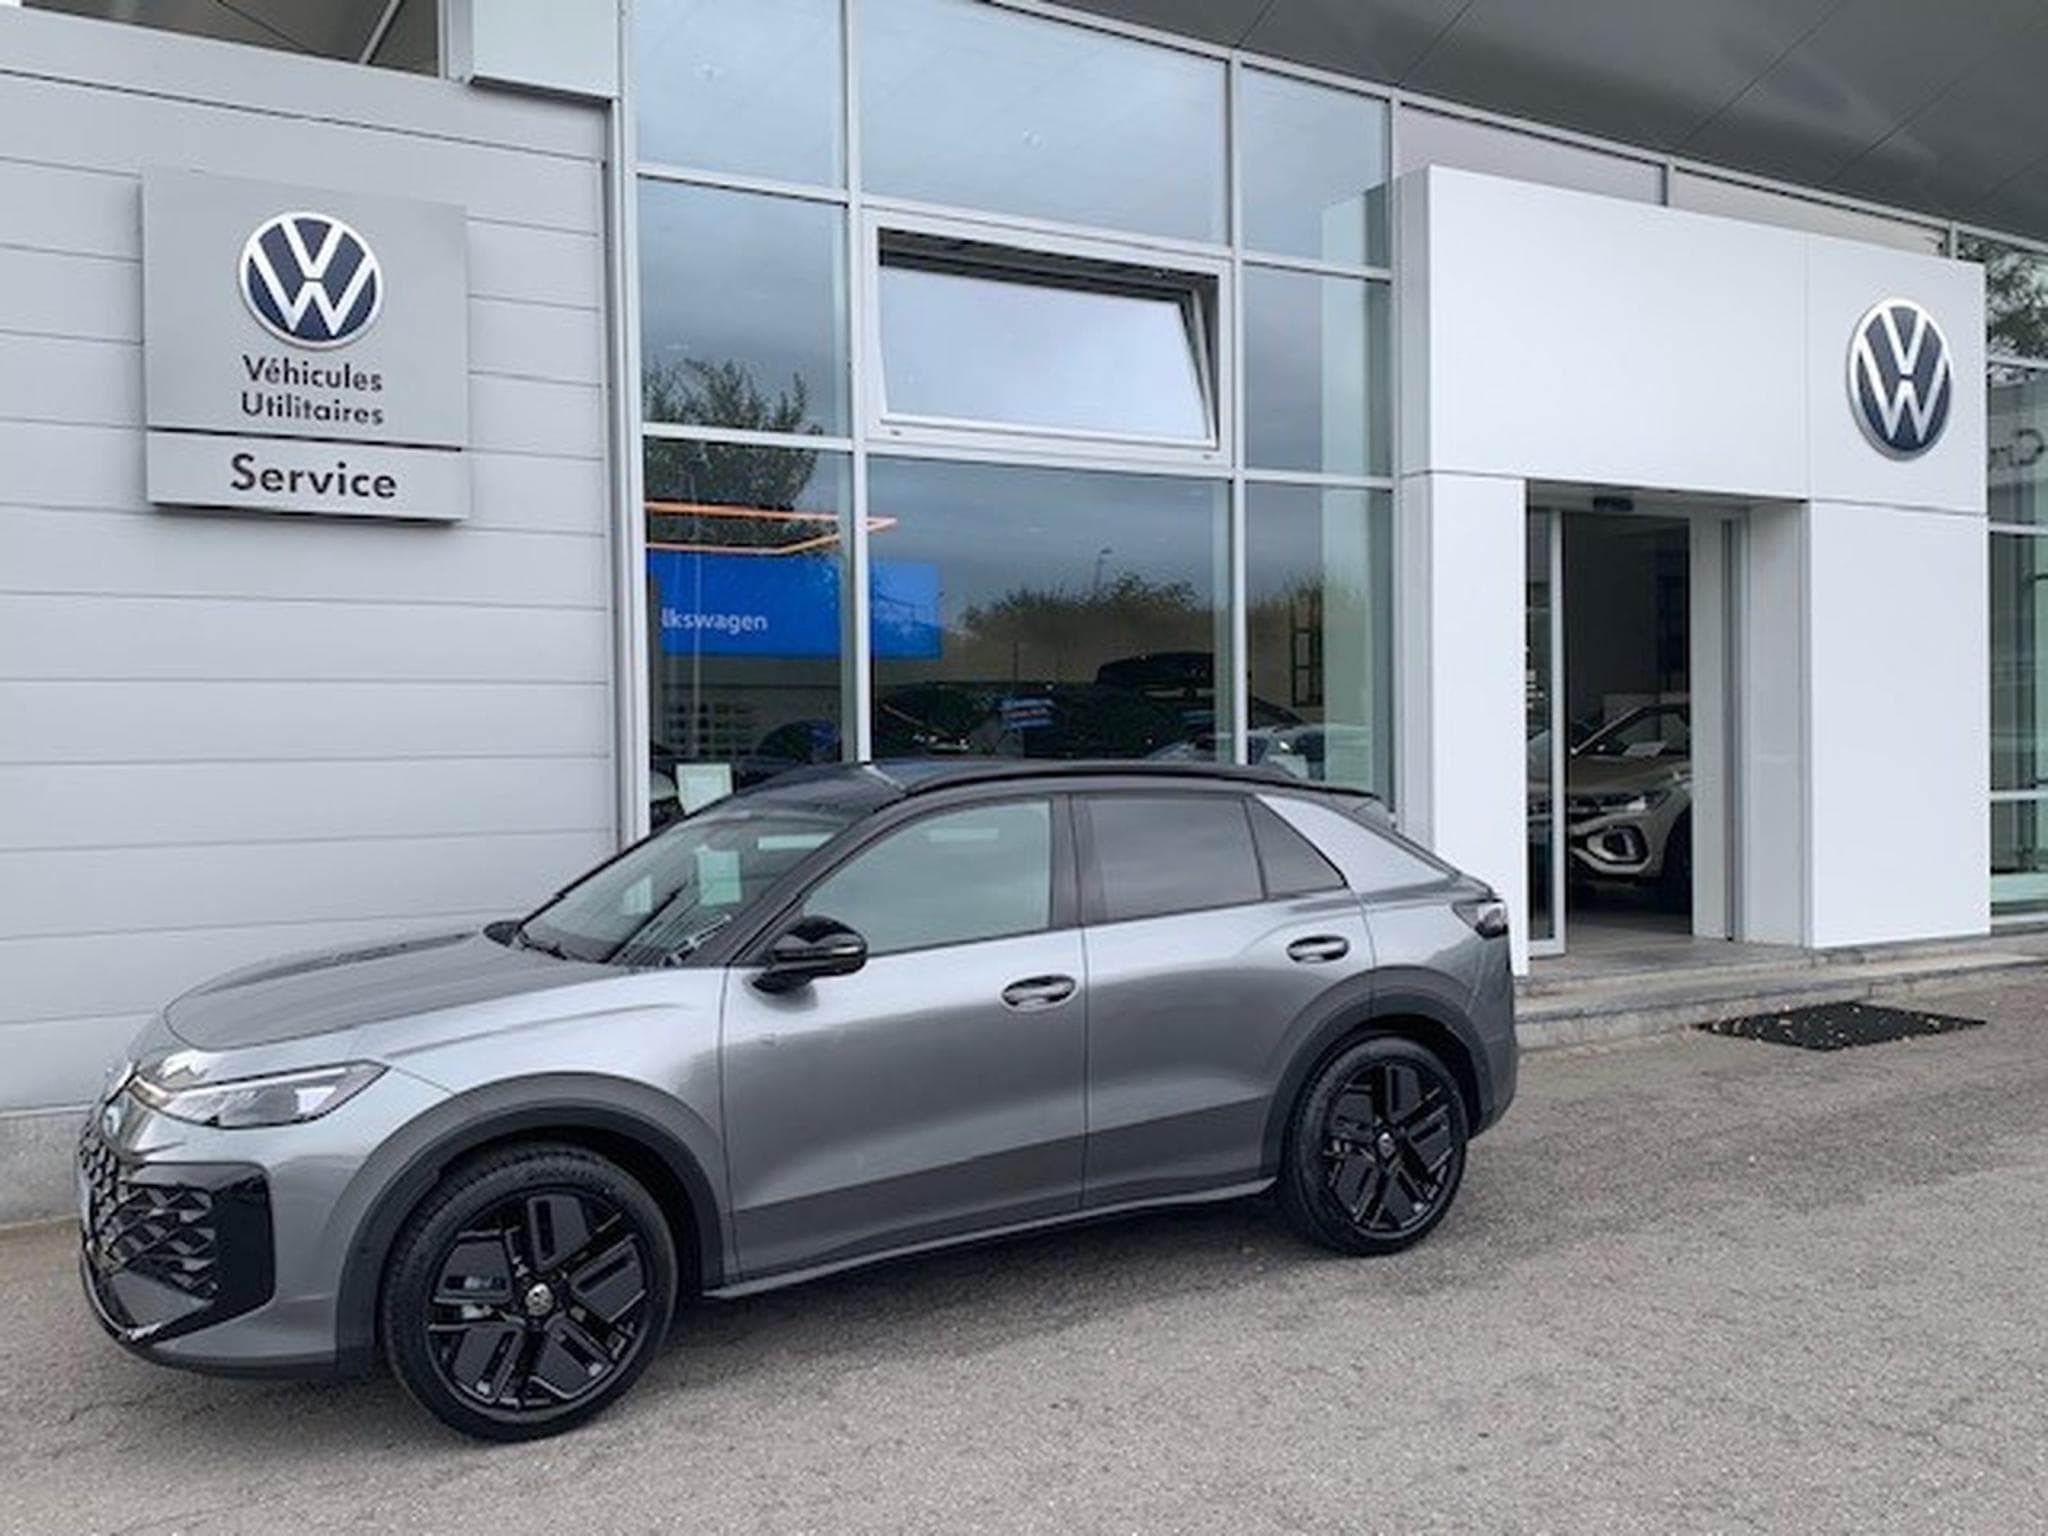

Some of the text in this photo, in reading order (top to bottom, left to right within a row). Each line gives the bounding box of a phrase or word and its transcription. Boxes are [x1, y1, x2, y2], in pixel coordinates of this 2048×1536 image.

[242, 354, 383, 392] Véhicules
[241, 392, 384, 426] Utilitaires
[230, 452, 397, 499] Service
